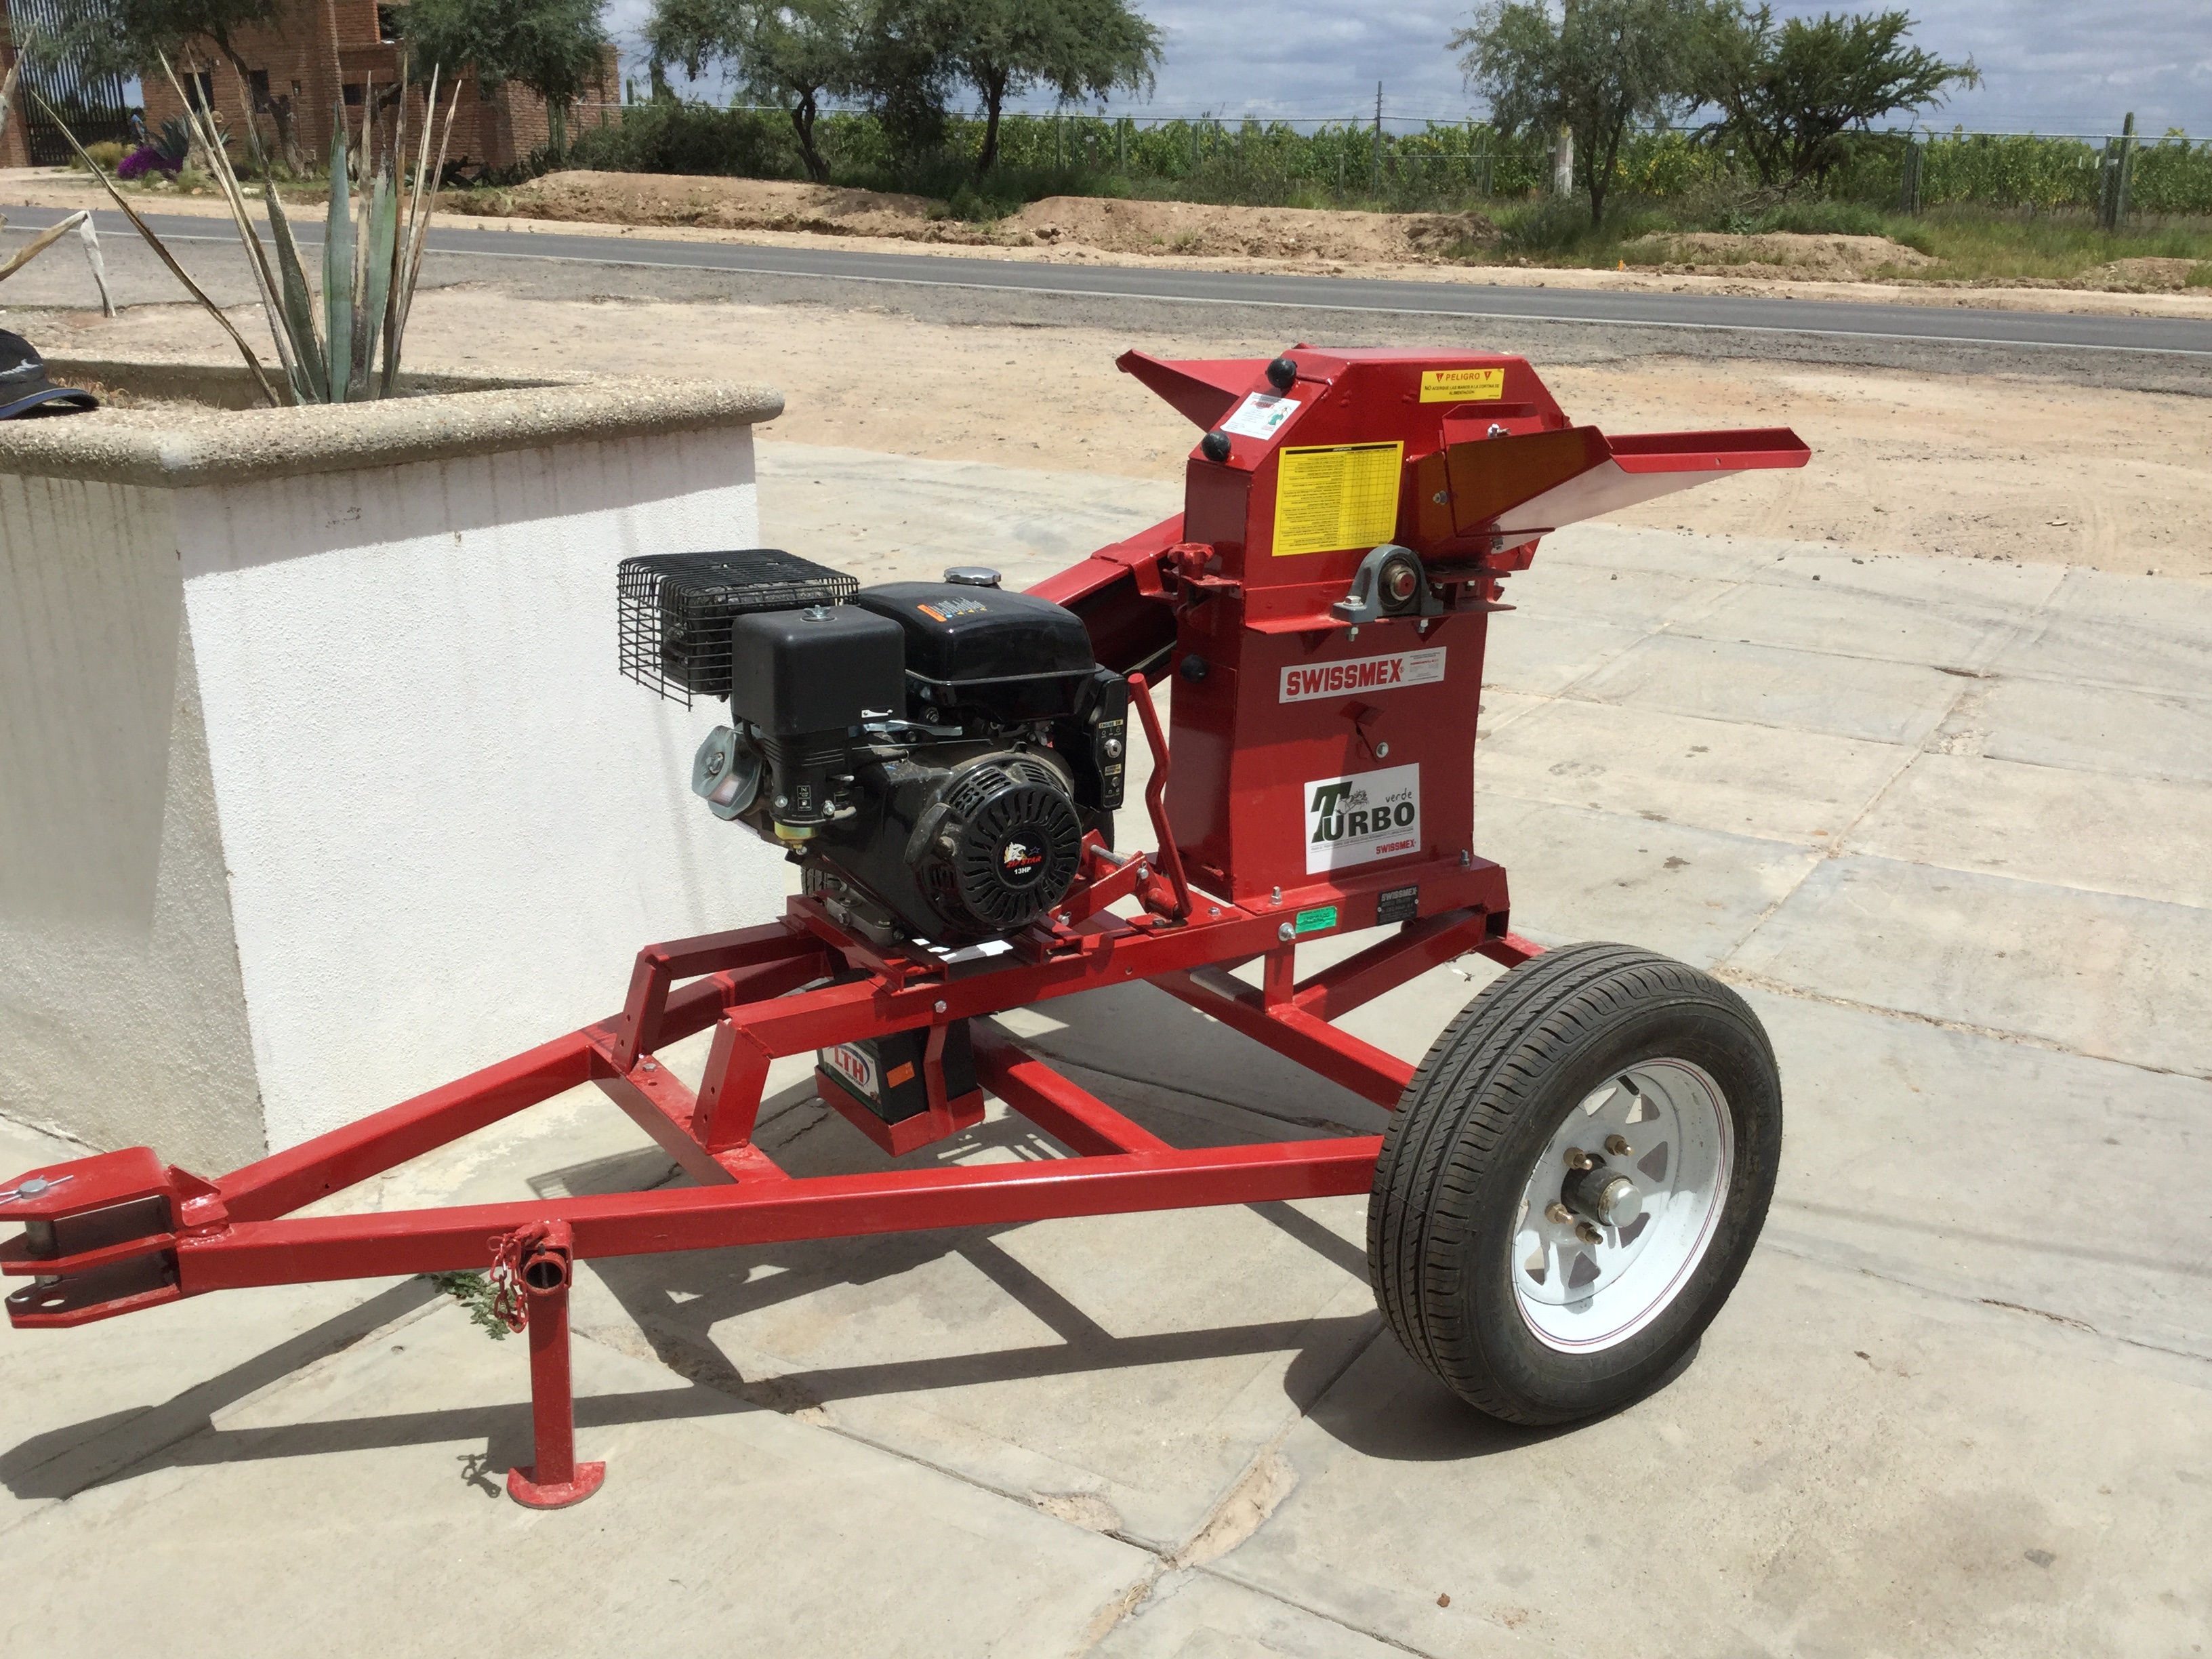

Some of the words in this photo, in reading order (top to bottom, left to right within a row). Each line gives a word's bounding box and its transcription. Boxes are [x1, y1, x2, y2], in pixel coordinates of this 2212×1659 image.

[1446, 372, 1480, 381] PELIGRO
[1385, 787, 1412, 803] verde
[1376, 838, 1415, 855] SWISSMEX
[1014, 866, 1031, 875] 13HP
[834, 1046, 864, 1084] LTH
